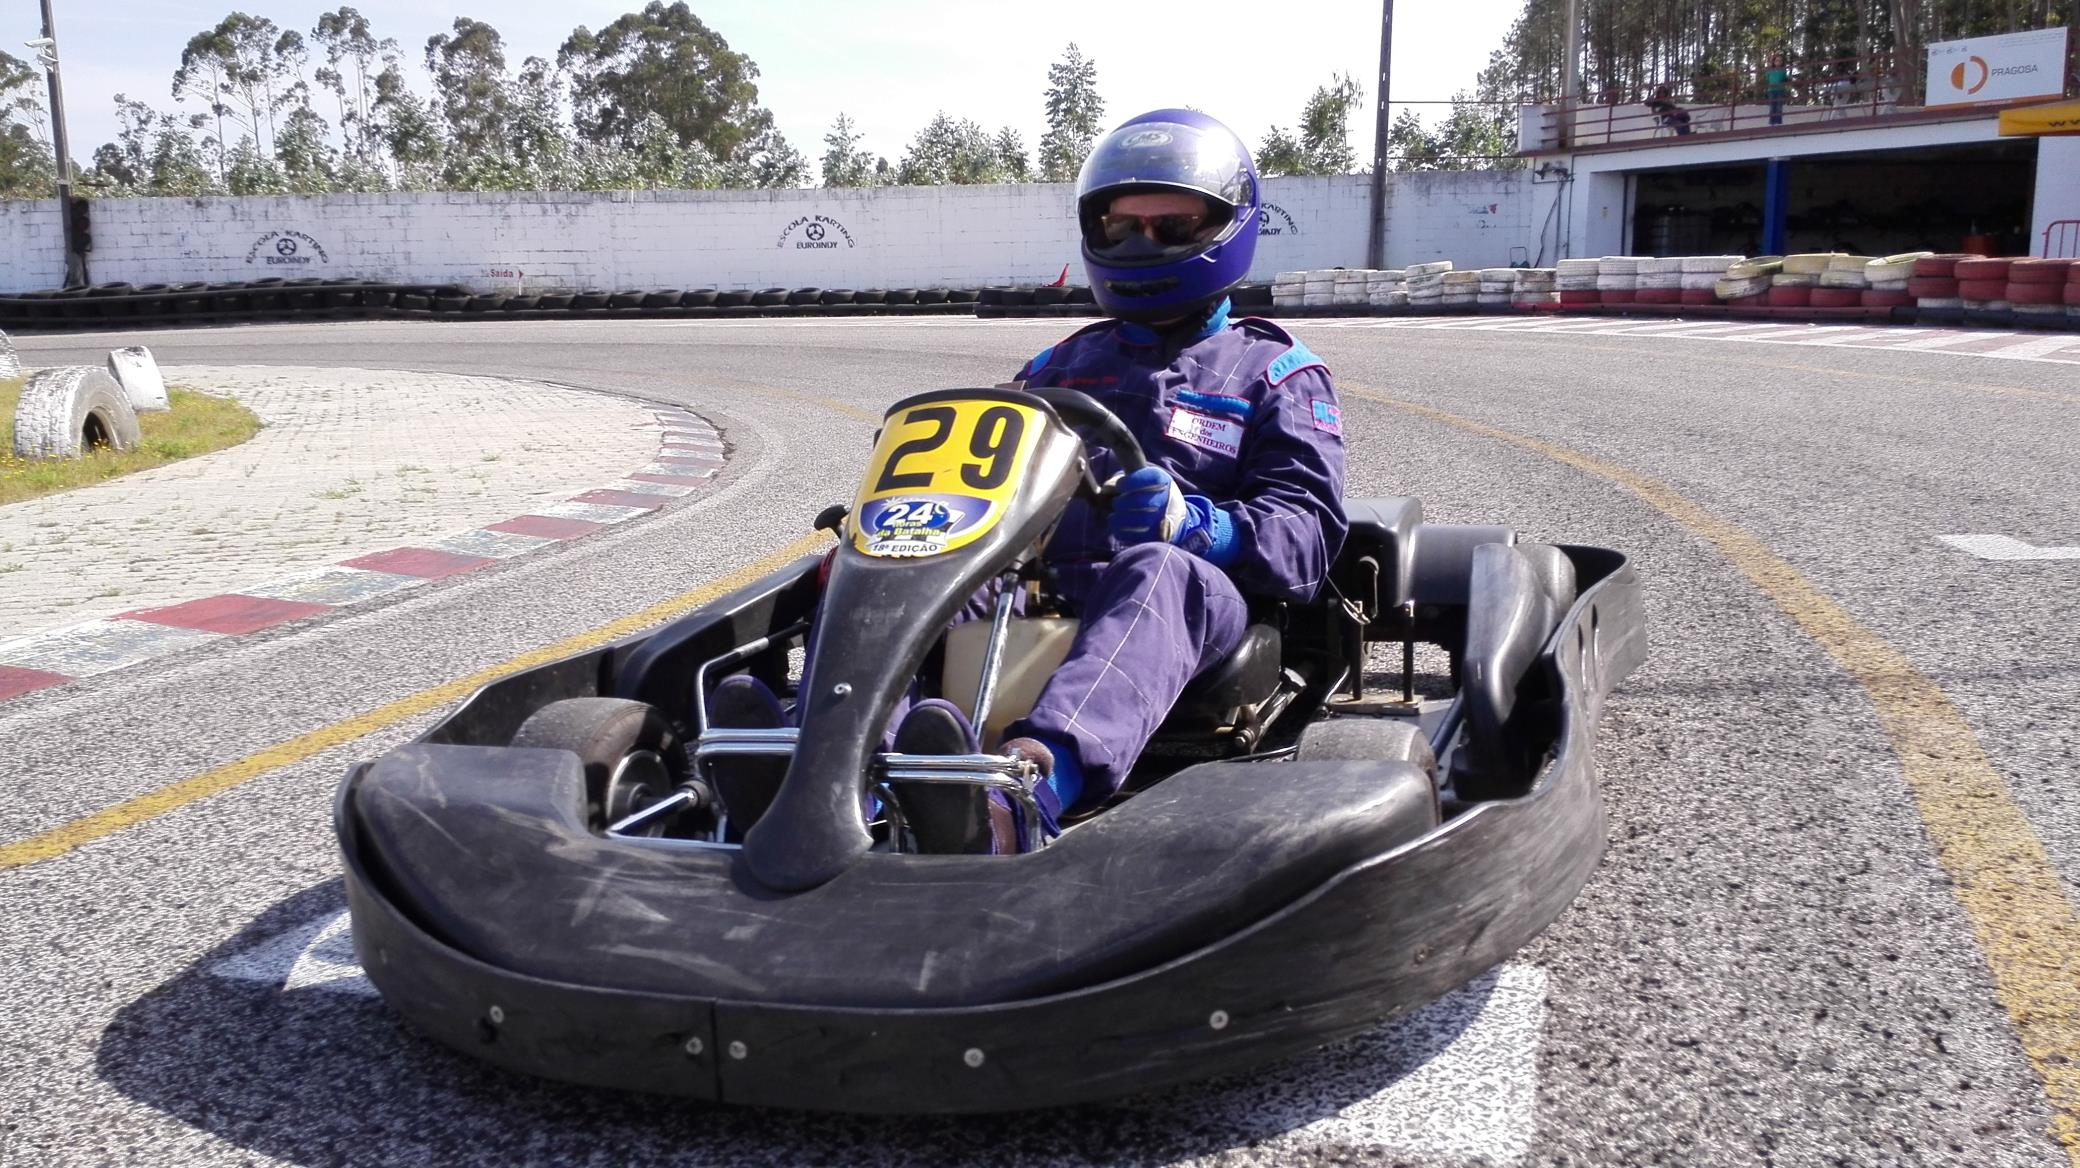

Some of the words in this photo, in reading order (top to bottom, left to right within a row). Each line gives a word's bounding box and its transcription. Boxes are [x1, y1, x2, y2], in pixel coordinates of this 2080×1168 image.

[1991, 64, 2039, 77] PRAGOSA
[1261, 202, 1298, 235] KARTING
[777, 216, 809, 248] ESCOLA
[815, 215, 855, 248] KARTING
[1258, 227, 1281, 236] INDY
[246, 231, 279, 264] ESCOLA
[285, 230, 328, 263] KARTING
[796, 241, 838, 249] EUROINDY
[1191, 417, 1226, 432] ORDEM
[1171, 427, 1237, 454] ENGENHEIROS
[1200, 428, 1213, 438] dos
[874, 405, 1025, 493] 29
[883, 502, 934, 527] 24
[877, 529, 891, 537] da
[894, 526, 941, 537] Batalha
[891, 544, 938, 552] EDIÇÃO
